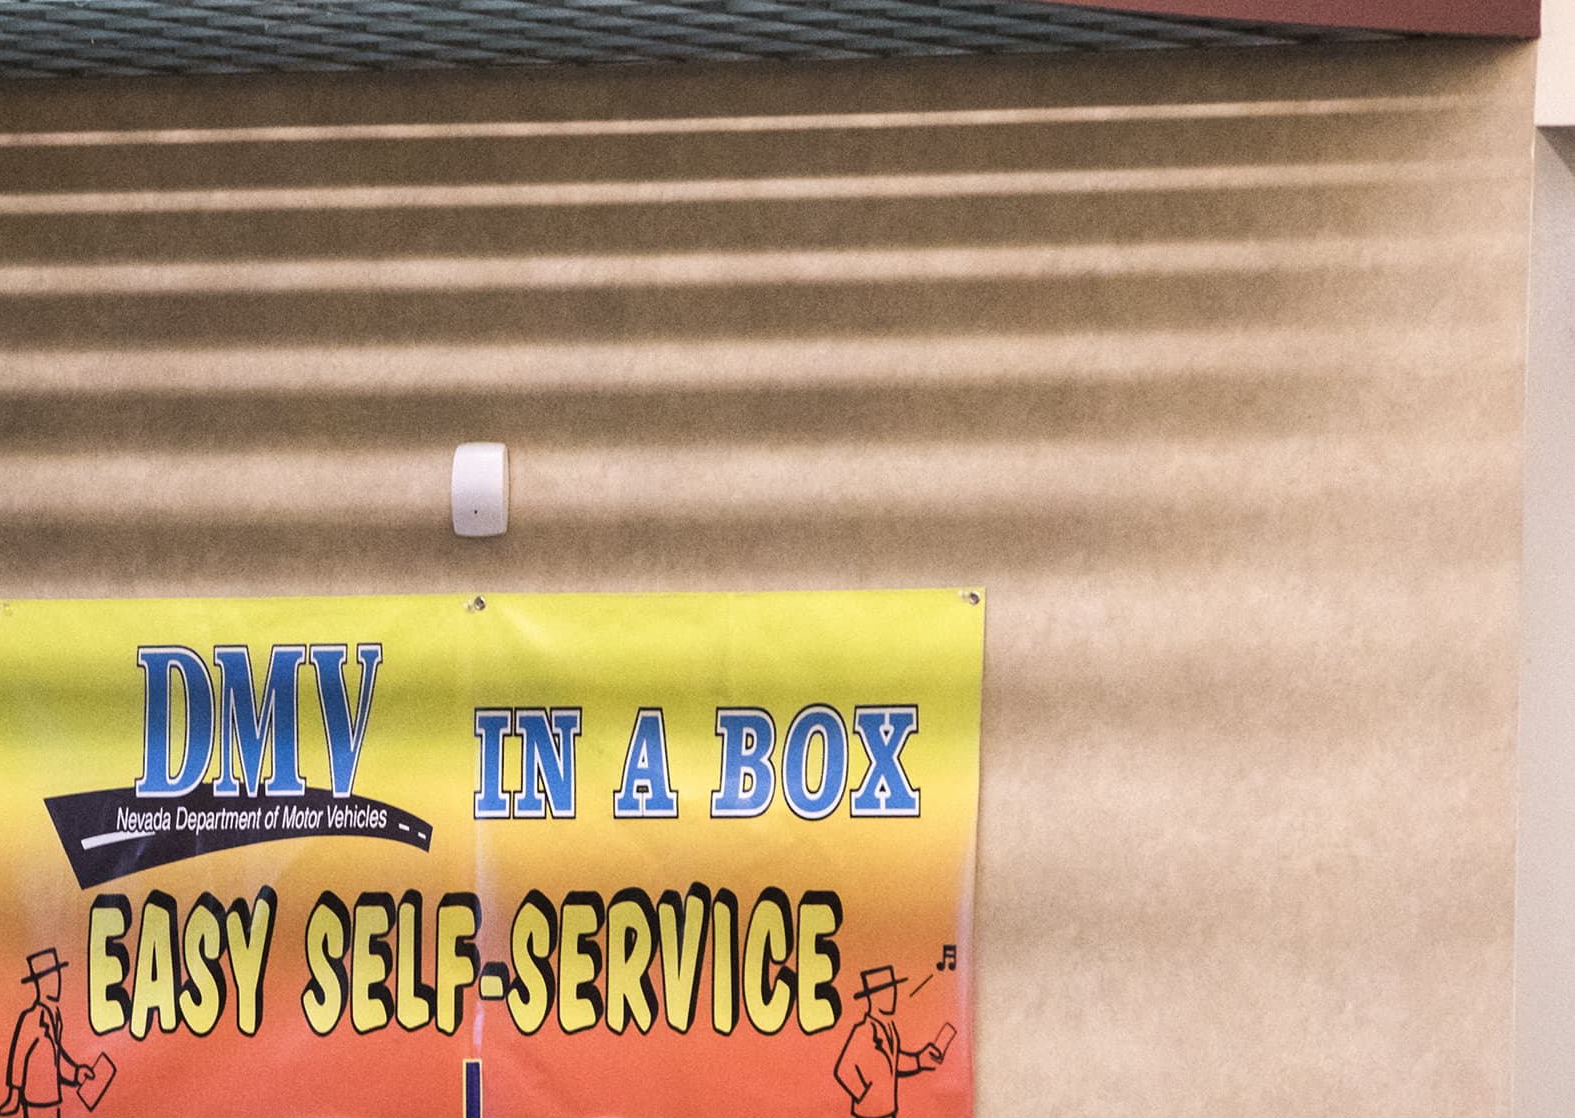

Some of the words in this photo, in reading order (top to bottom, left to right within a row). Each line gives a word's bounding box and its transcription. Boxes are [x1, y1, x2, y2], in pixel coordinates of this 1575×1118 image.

[134, 643, 384, 799] DMV
[473, 707, 582, 819] IN
[614, 709, 679, 819] A
[710, 703, 921, 820] BOX
[116, 806, 171, 832] Nevada
[175, 806, 260, 835] Department
[264, 806, 280, 829] of
[282, 805, 324, 829] Motor
[326, 805, 388, 829] Vehicles
[85, 884, 279, 1041] EASY
[301, 882, 845, 1041] SELF-SERVICE
